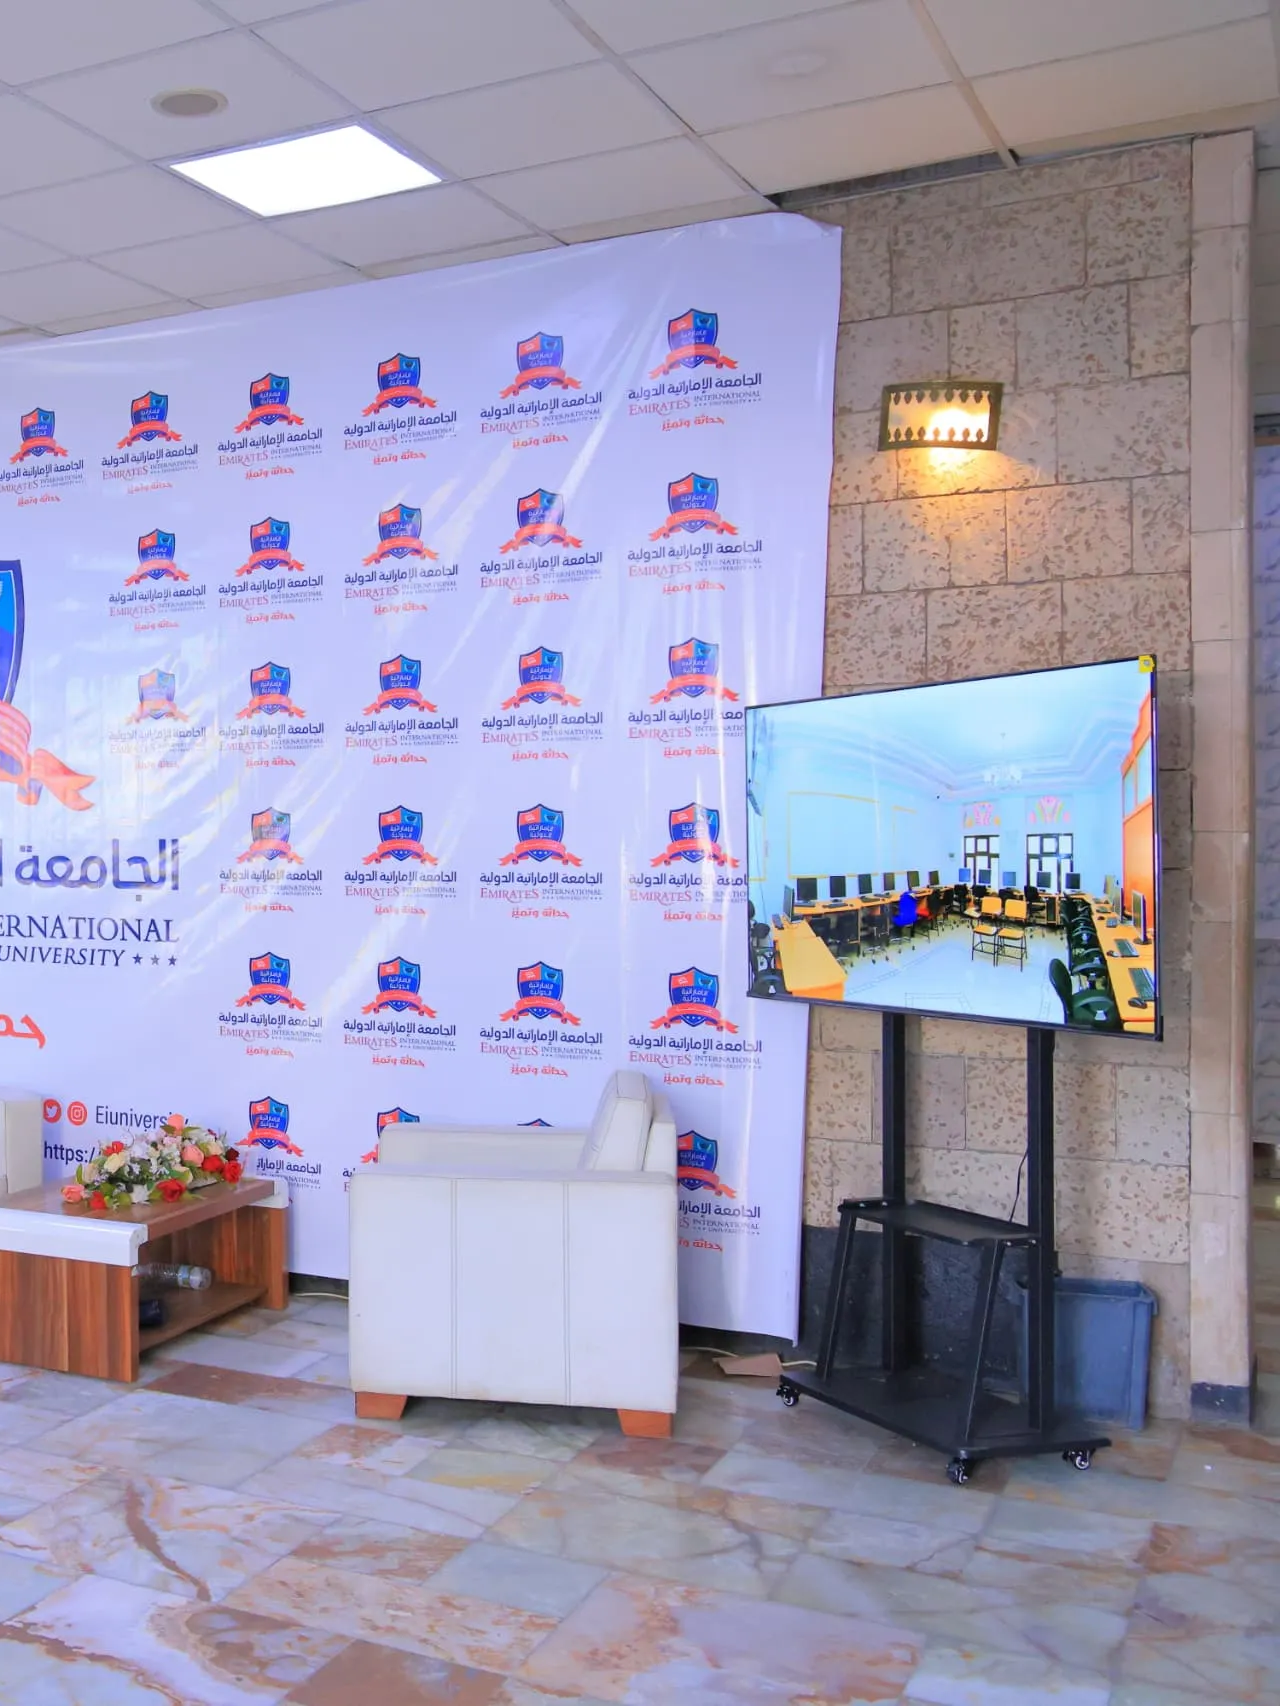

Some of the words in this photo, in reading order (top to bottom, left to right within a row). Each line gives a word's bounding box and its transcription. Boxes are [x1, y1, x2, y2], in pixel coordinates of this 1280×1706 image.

[715, 371, 761, 389] الجامعة
[561, 391, 602, 408] الجامعة
[627, 383, 665, 401] الدولية
[628, 398, 692, 416] EMIRATES
[695, 389, 759, 403] INTERNATIONAL
[418, 410, 457, 426] الجامعة
[481, 403, 515, 421] الدولية
[344, 421, 376, 438] الدولية
[481, 417, 540, 435] EMIRATES
[542, 408, 601, 422] INTERNATIONAL
[287, 427, 322, 443] الجامعة
[344, 434, 398, 452] EMIRATES
[401, 427, 455, 439] INTERNATIONAL
[218, 437, 248, 454] الدولية
[219, 450, 269, 467] EMIRATES
[271, 443, 321, 455] INTERNATIONAL
[628, 546, 665, 563] الدولية
[716, 538, 761, 555] الجامعة
[628, 562, 692, 580] EMIRATES
[219, 581, 248, 596] الدولية
[287, 574, 323, 589] الجامعة
[219, 595, 269, 611] EMIRATES
[271, 590, 322, 600] INTERNATIONAL
[345, 585, 400, 601] EMIRATES
[418, 717, 455, 732] الجامعة
[482, 715, 515, 731] الدولية
[560, 711, 601, 726] الجامعة
[346, 736, 398, 751] EMIRATES
[482, 731, 539, 747] EMIRATES
[15, 838, 179, 902] الجامعة
[480, 872, 514, 886] الدولية
[561, 872, 603, 887] الجامعة
[346, 886, 400, 901] EMIRATES
[480, 888, 539, 904] EMIRATES
[542, 888, 602, 896] INTERNATIONAL
[219, 1012, 249, 1026] الدولية
[287, 1016, 323, 1030] الجامعة
[344, 1019, 375, 1034] الدولية
[220, 1026, 269, 1042] EMIRATES
[271, 1029, 322, 1038] INTERNATIONAL
[417, 1024, 456, 1038] الجامعة
[480, 1027, 514, 1042] الدولية
[560, 1031, 602, 1047] الجامعة
[344, 1034, 398, 1051] EMIRATES
[400, 1037, 454, 1047] INTERNATIONAL
[629, 1035, 666, 1050] الدولية
[716, 1039, 760, 1055] الجامعة
[480, 1042, 539, 1060] EMIRATES
[541, 1046, 600, 1056] INTERNATIONAL
[630, 1051, 693, 1069] EMIRATES
[695, 1054, 759, 1065] INTERNATIONAL
[95, 1105, 189, 1129] Eiunivers
[286, 1163, 322, 1177] الجامعة
